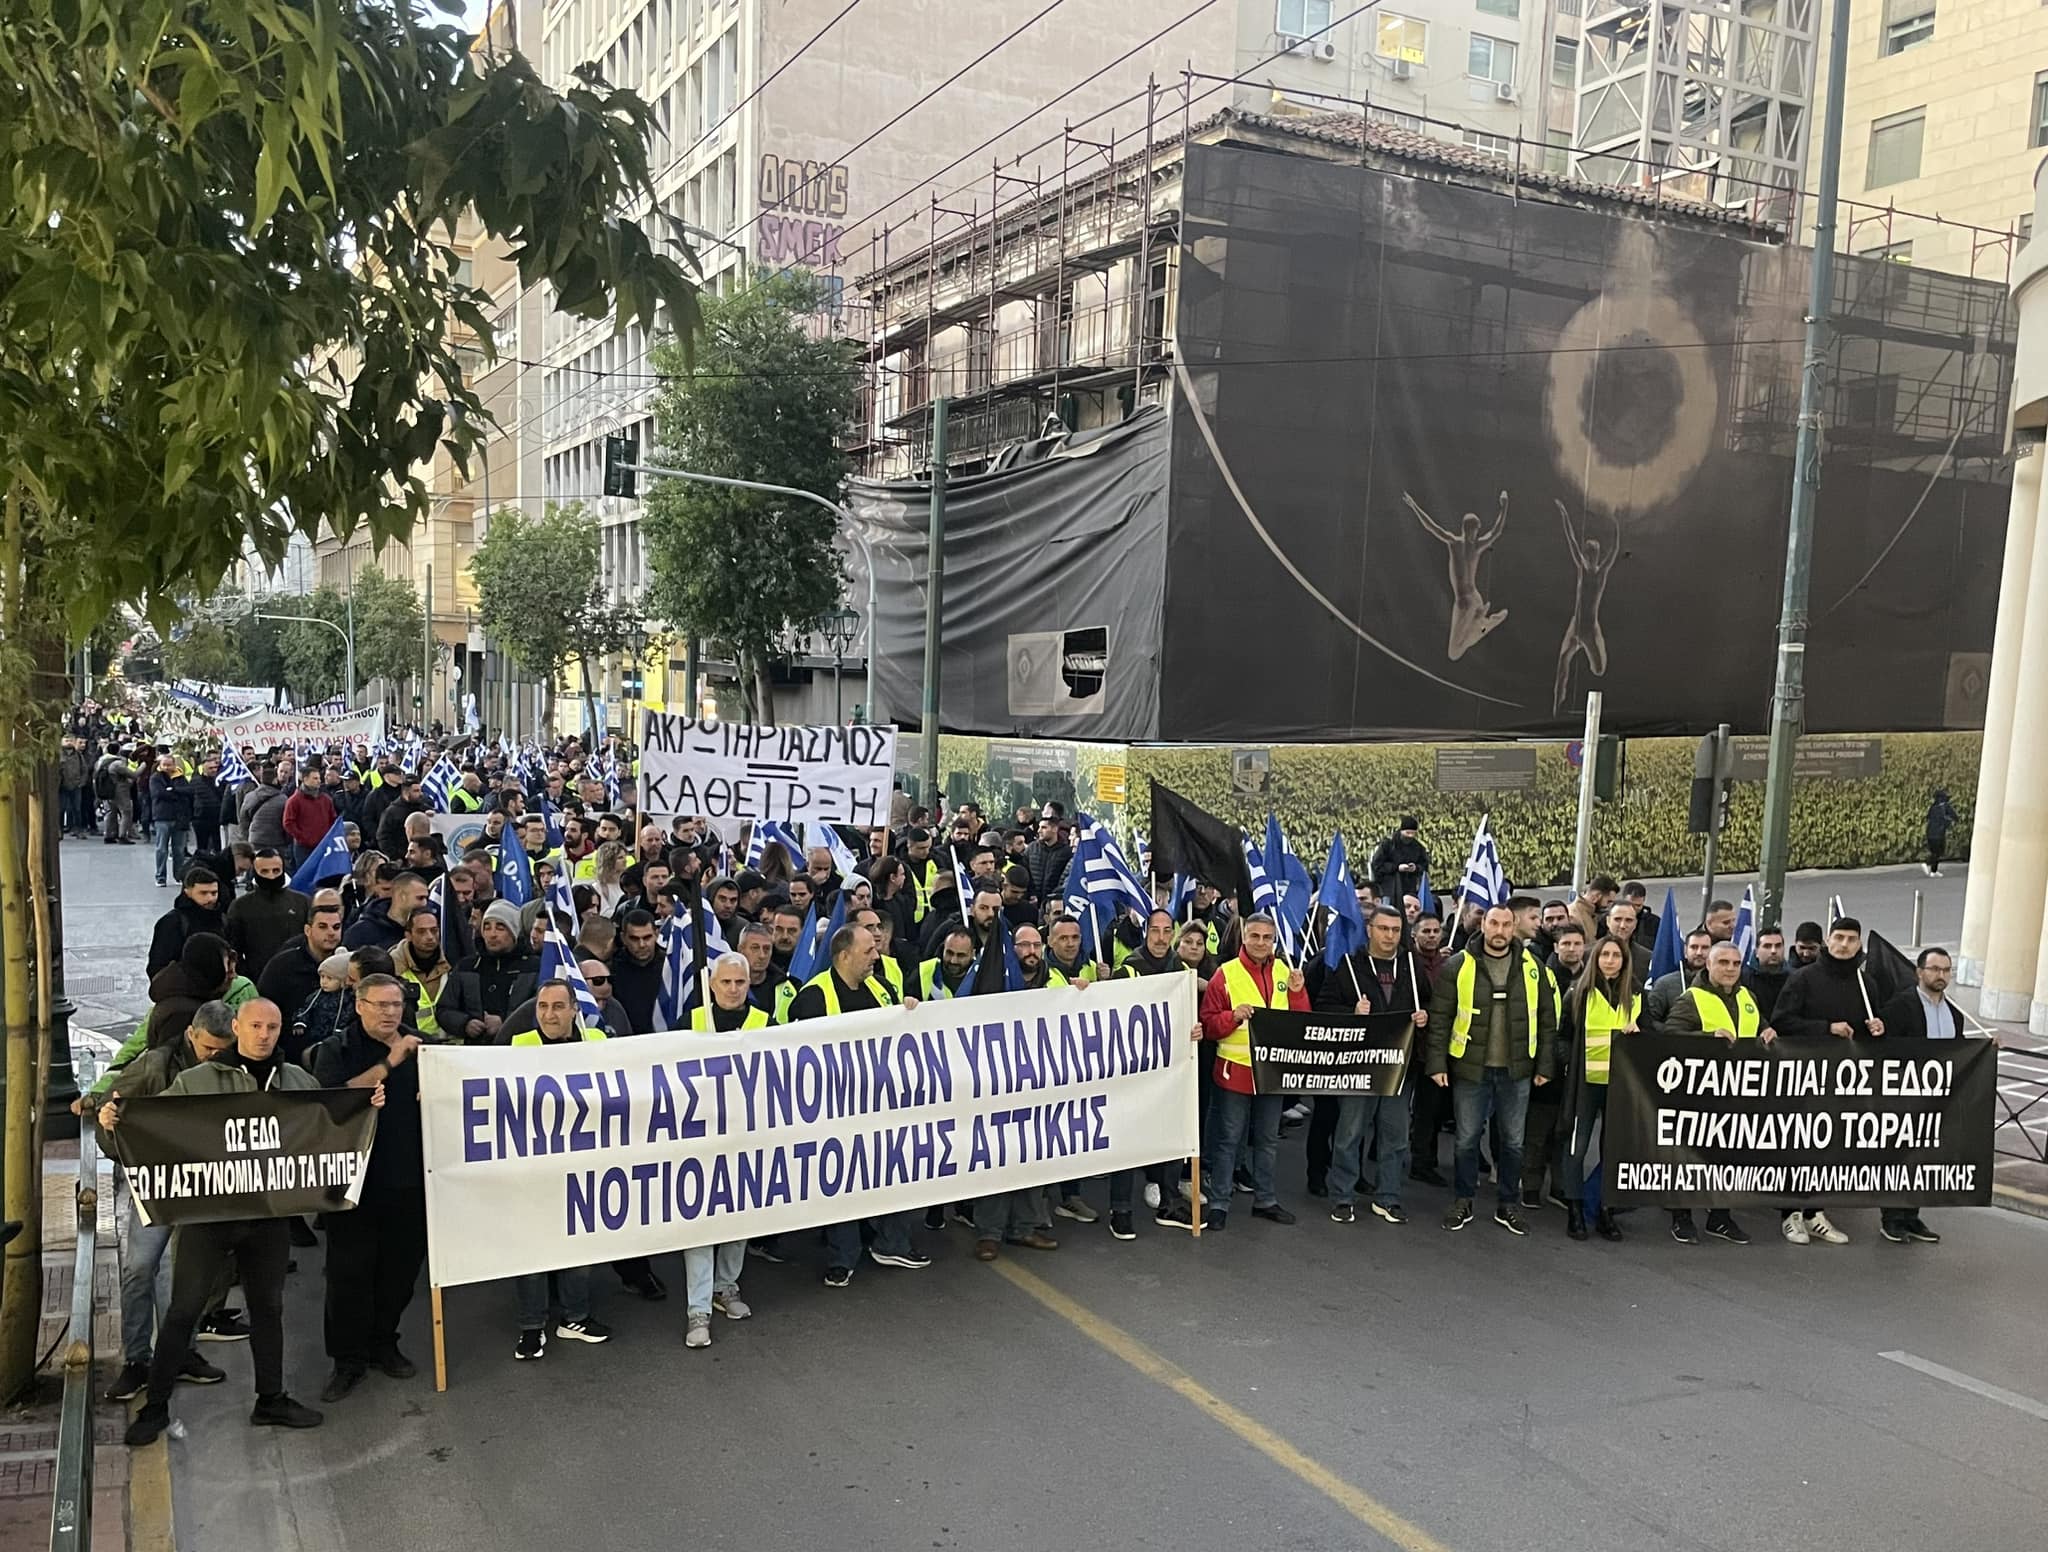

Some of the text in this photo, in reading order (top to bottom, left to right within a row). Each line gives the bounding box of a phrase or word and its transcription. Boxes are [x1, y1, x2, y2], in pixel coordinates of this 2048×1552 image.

[234, 725, 249, 736] ΟΙ
[644, 772, 878, 824] ΚΑΘΕΙΡΞΗ
[1304, 1026, 1366, 1042] ΣΕΒΑΣΤΕΙΤΕ
[1254, 1047, 1405, 1065] ΤΟ ΕΠΙΚΙΝΔΥΝΟ ΛΕΙΤΟΥΡΓΗΜΑ
[462, 1001, 1171, 1163] ΕΝΩΣΗ ΑΣΤΥΝΟΜΙΚΩΝ ΥΠΑΛΛΗΛΩΝ
[1282, 1073, 1371, 1089] ΠΟΥ ΕΠΙΤΕΛΟΥΜΕ
[1656, 1056, 1953, 1097] ΦΤΑΝΕΙ ΠΙΑ! ΩΣ ΕΔΩ!
[224, 1116, 280, 1152] ΩΣ ΕΔΩ
[1656, 1109, 1942, 1149] ΕΠΙΚΙΝΔΥΝΟ ΤΩΡΑ!!!
[154, 1164, 166, 1199] Η
[170, 1158, 264, 1198] ΑΣΤΥΝΟΜΙΑ
[267, 1155, 296, 1190] ΑΠΟ
[298, 1154, 317, 1188] ΤΑ
[566, 1095, 1109, 1236] ΝΟΤΙΟΑΝΑΤΟΛΙΚΗΣ ΑΤΤΙΚΗΣ
[1617, 1163, 1671, 1191] ΕΝΩΣΗ
[1675, 1164, 1788, 1192] ΑΣΤΥΝΟΜΙΚΩΝ
[1790, 1165, 1880, 1192] ΥΠΑΛΛΗΛΩΝ
[1914, 1165, 1976, 1191] ΑΤΤΙΚΗΣ
